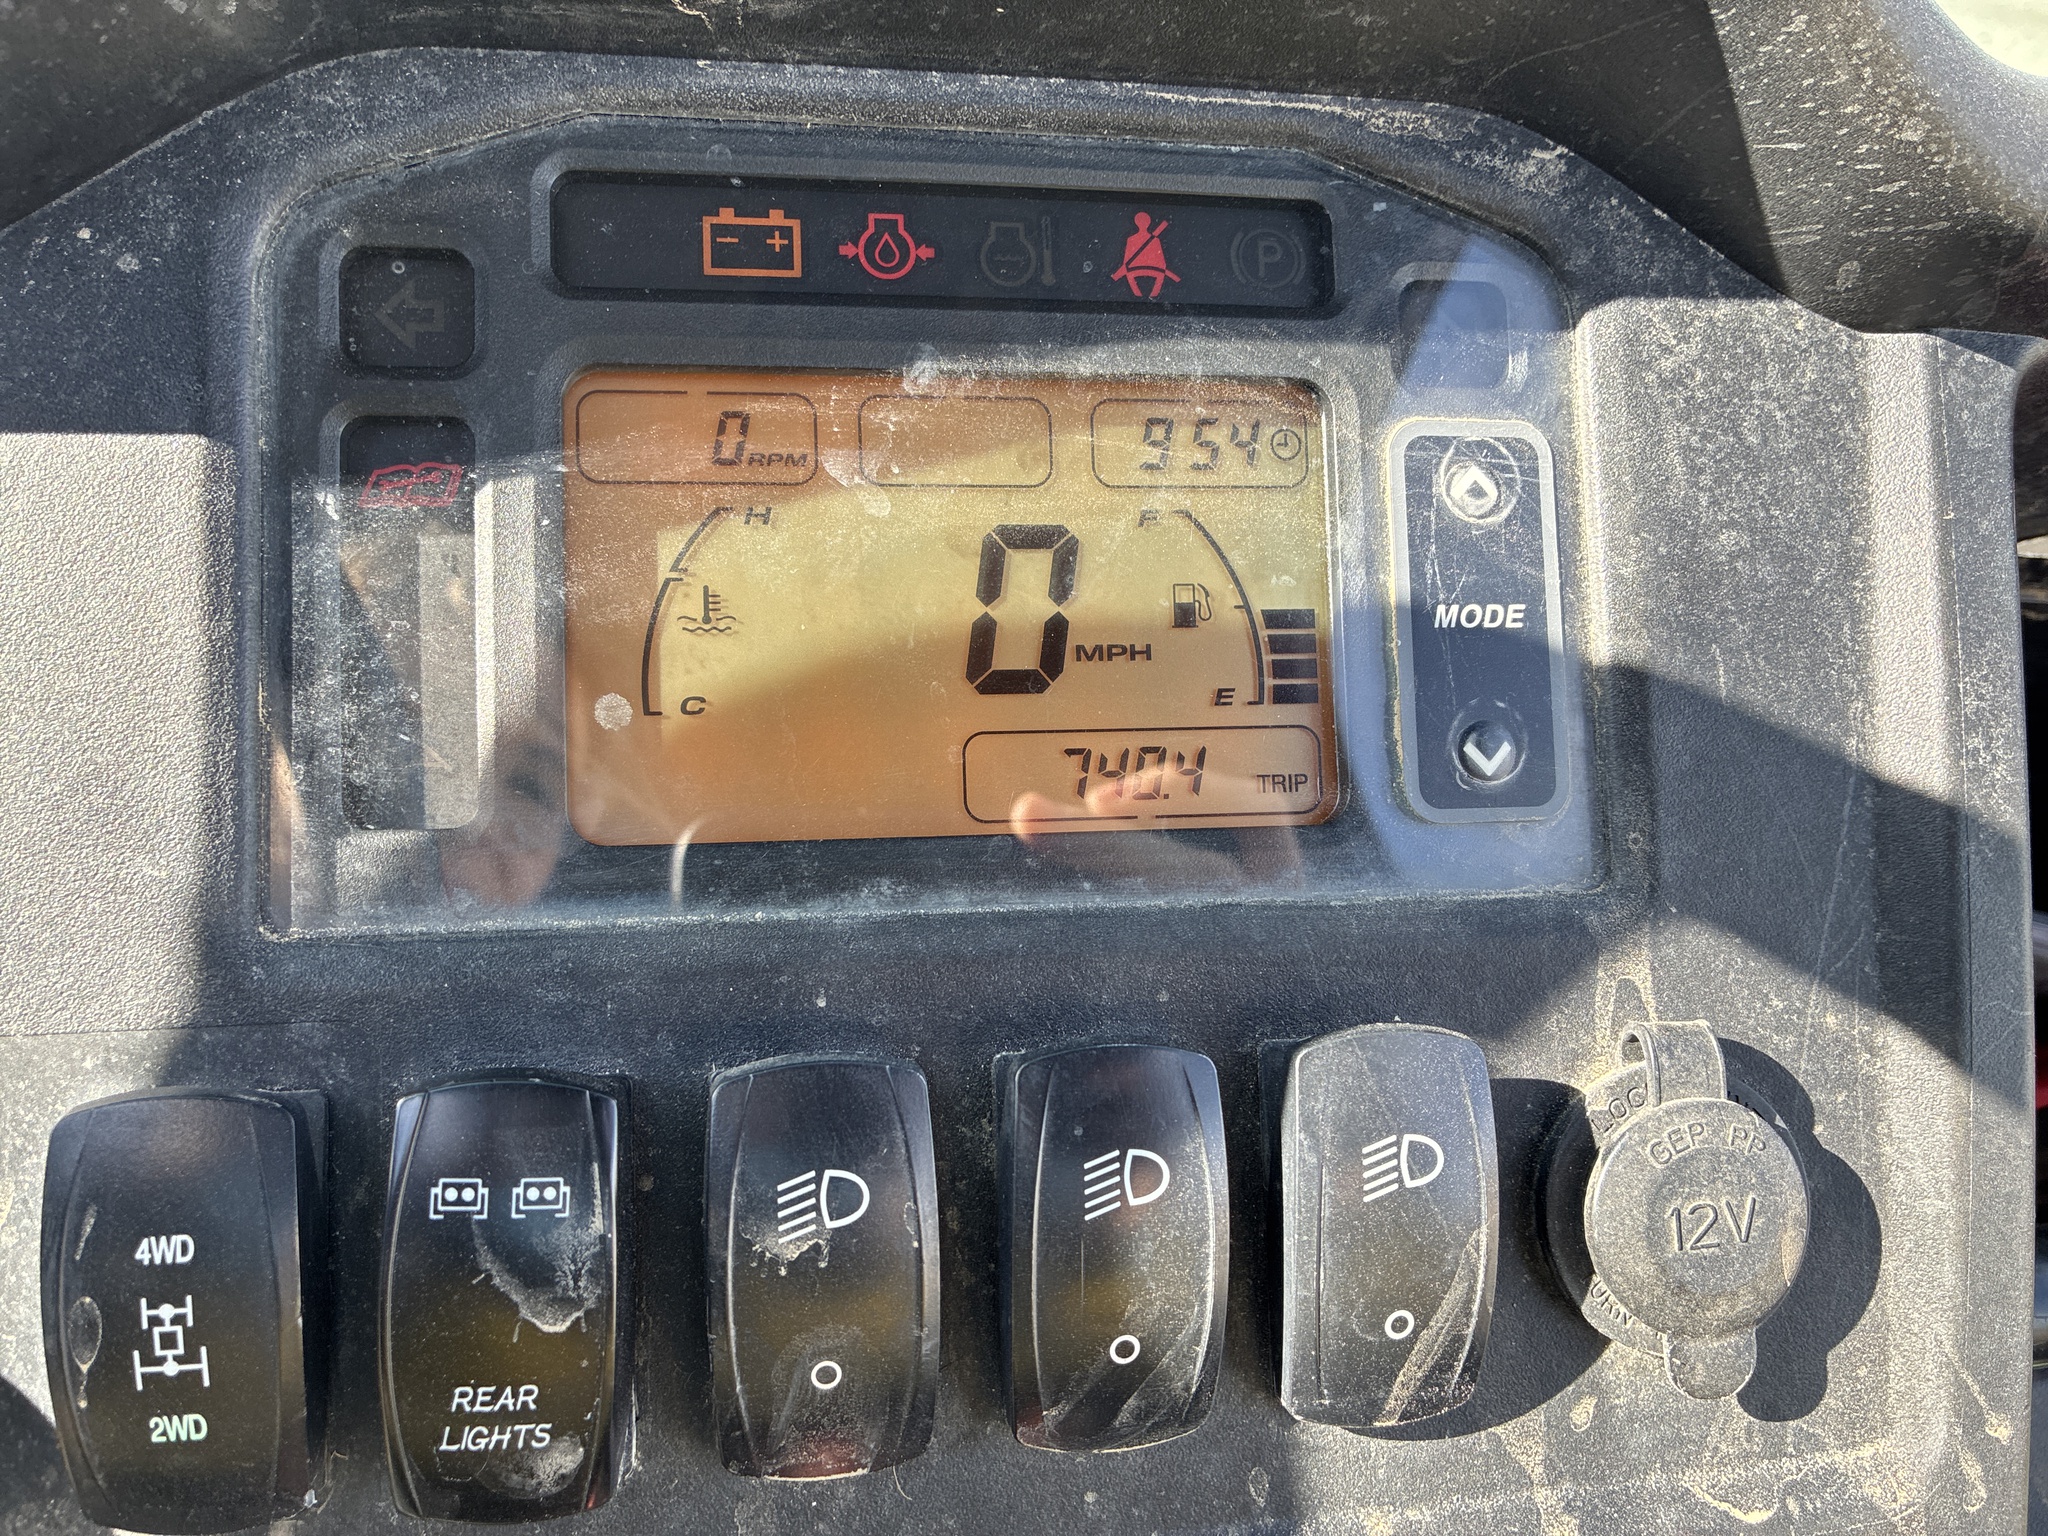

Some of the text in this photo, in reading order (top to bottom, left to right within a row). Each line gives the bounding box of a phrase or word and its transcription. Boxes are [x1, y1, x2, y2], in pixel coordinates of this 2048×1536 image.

[712, 411, 809, 467] 0 RPM
[743, 506, 773, 526] H
[1137, 509, 1160, 528] F
[965, 523, 1153, 695] 0 MPH
[1433, 603, 1527, 629] MODE
[679, 695, 708, 717] C
[1213, 687, 1237, 707] E
[1063, 745, 1309, 801] 740.4 TRIP
[1649, 1121, 1768, 1165] GEP PP
[1669, 1196, 1758, 1253] 12V
[134, 1234, 196, 1266] 4WD
[450, 1385, 540, 1414] REAR
[148, 1414, 209, 1445] 2WD
[438, 1423, 553, 1453] LIGHTS
